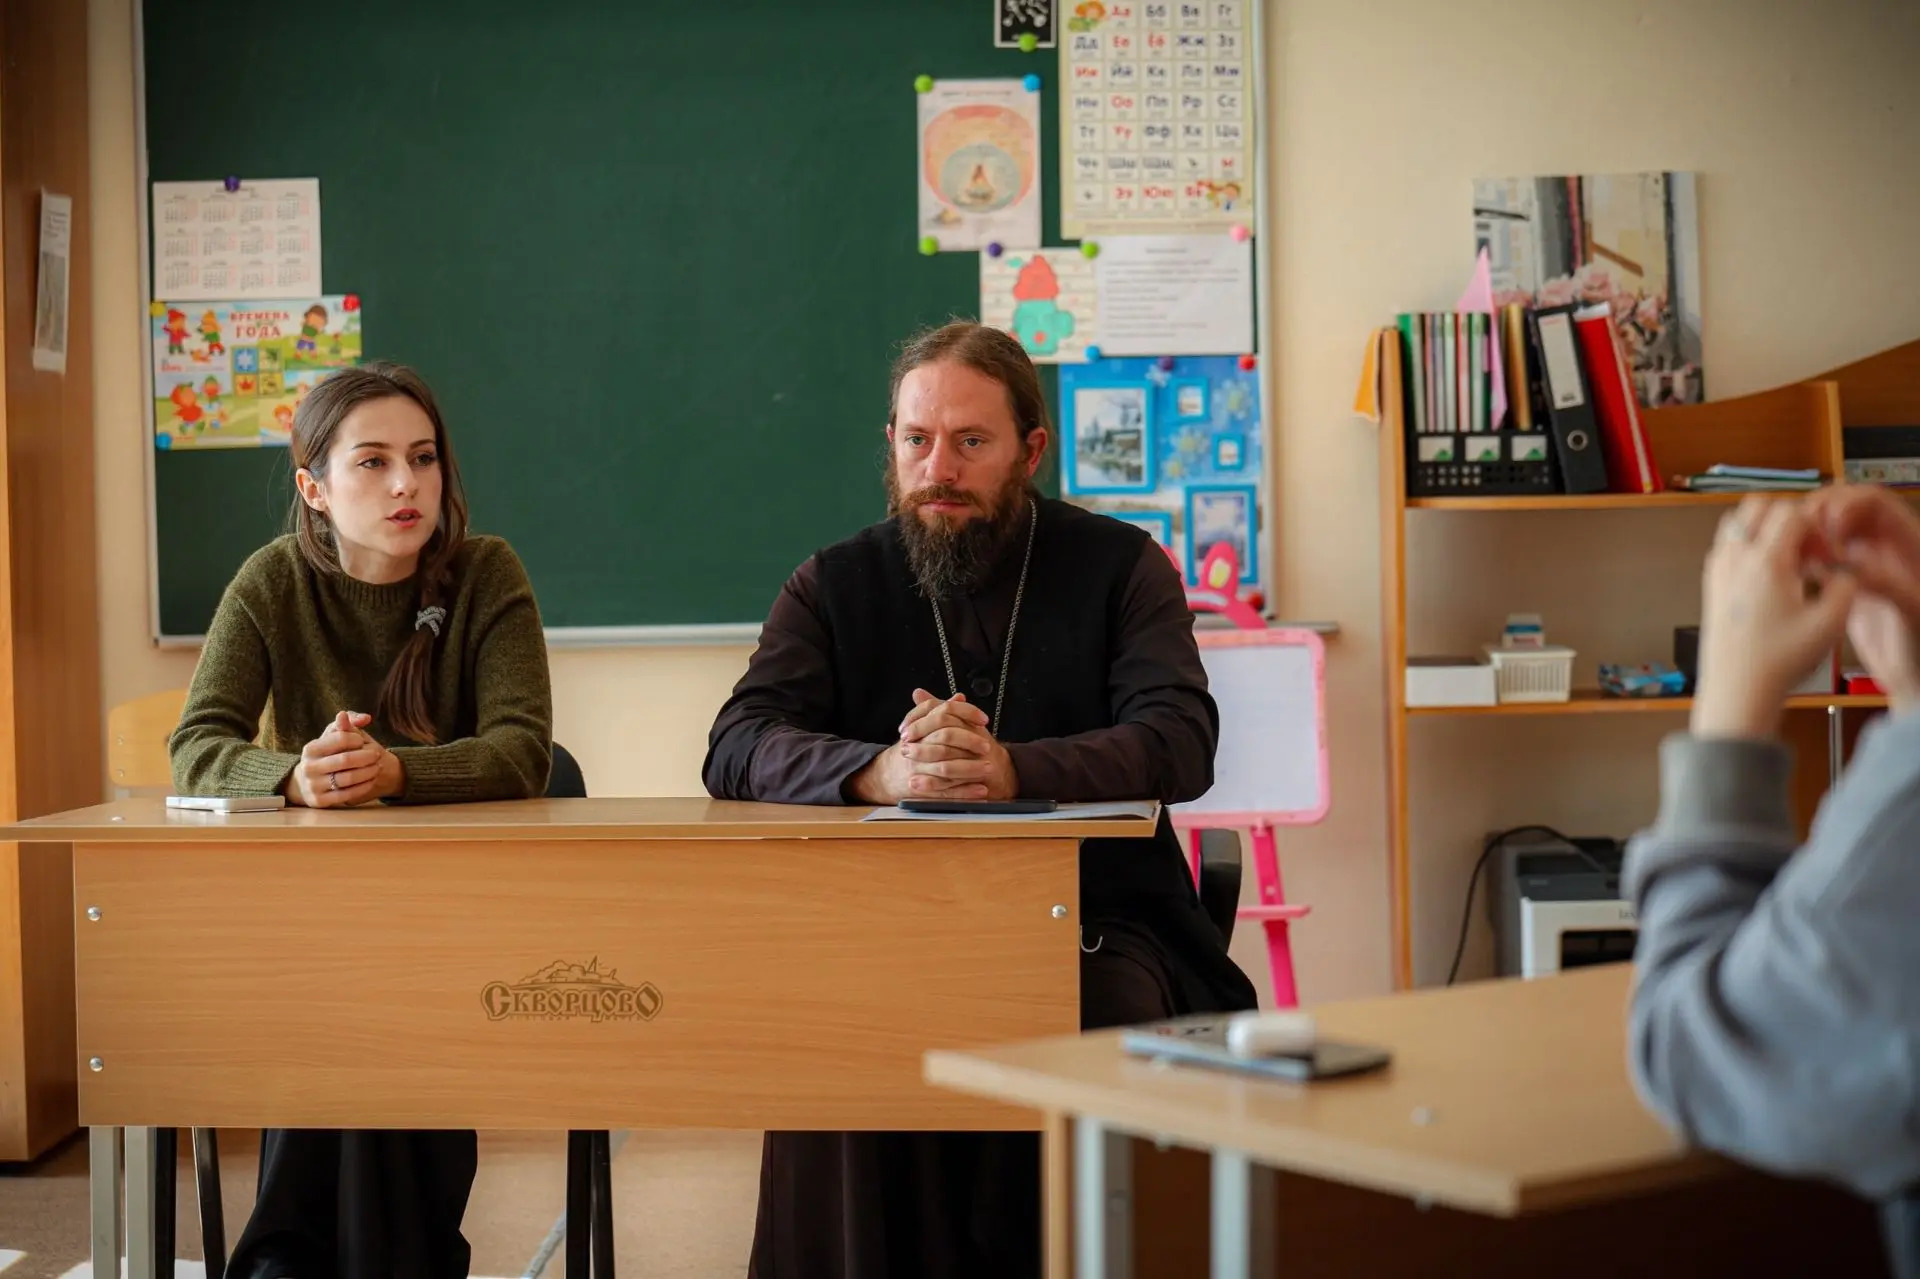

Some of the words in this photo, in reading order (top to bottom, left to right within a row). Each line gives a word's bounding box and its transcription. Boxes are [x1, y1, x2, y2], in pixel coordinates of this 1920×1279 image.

[1146, 5, 1166, 17] Бб
[1218, 4, 1232, 16] Гг
[1111, 95, 1133, 109] Оо
[230, 311, 289, 321] ВРЕМЕНА
[236, 325, 282, 339] ГОДА
